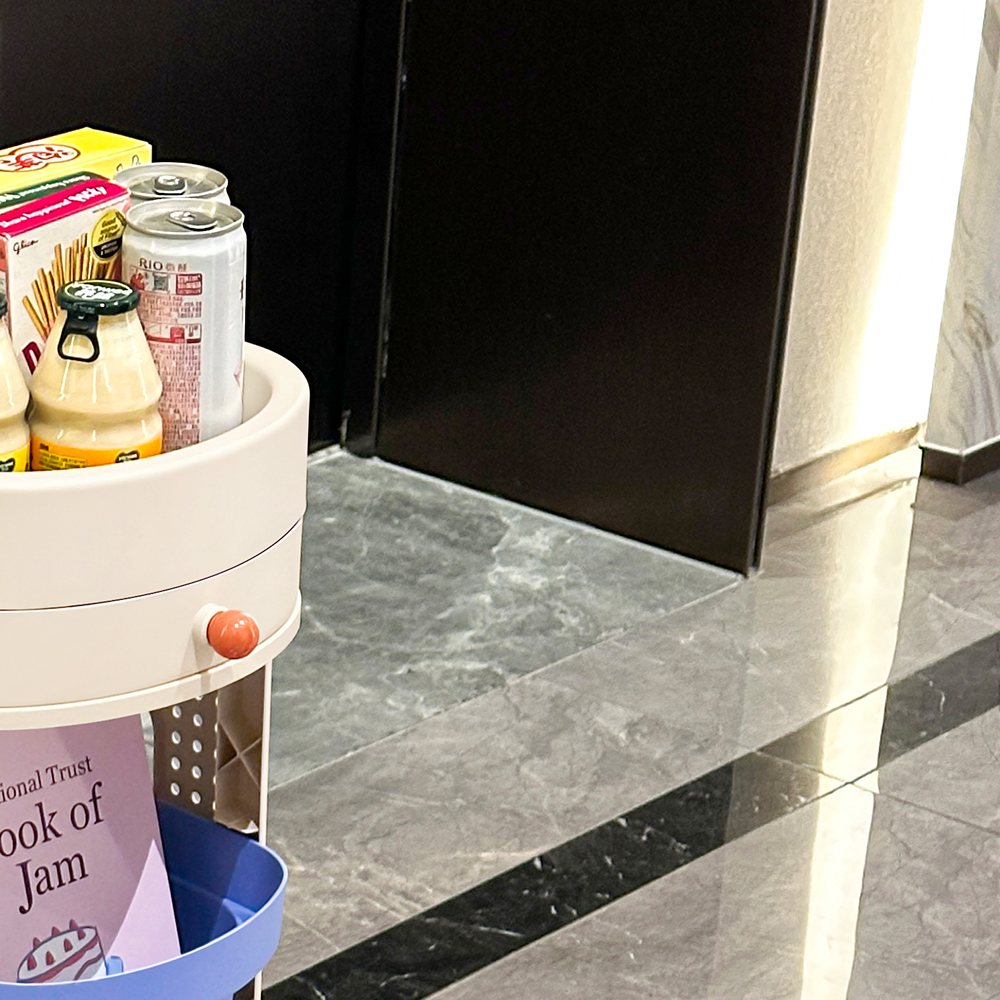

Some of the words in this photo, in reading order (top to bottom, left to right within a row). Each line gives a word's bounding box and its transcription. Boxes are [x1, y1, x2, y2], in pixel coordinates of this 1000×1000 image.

[67, 185, 108, 203] Pocky
[139, 257, 164, 271] RIO
[45, 755, 93, 786] Trust
[69, 781, 105, 831] of
[15, 852, 89, 915] Jam
